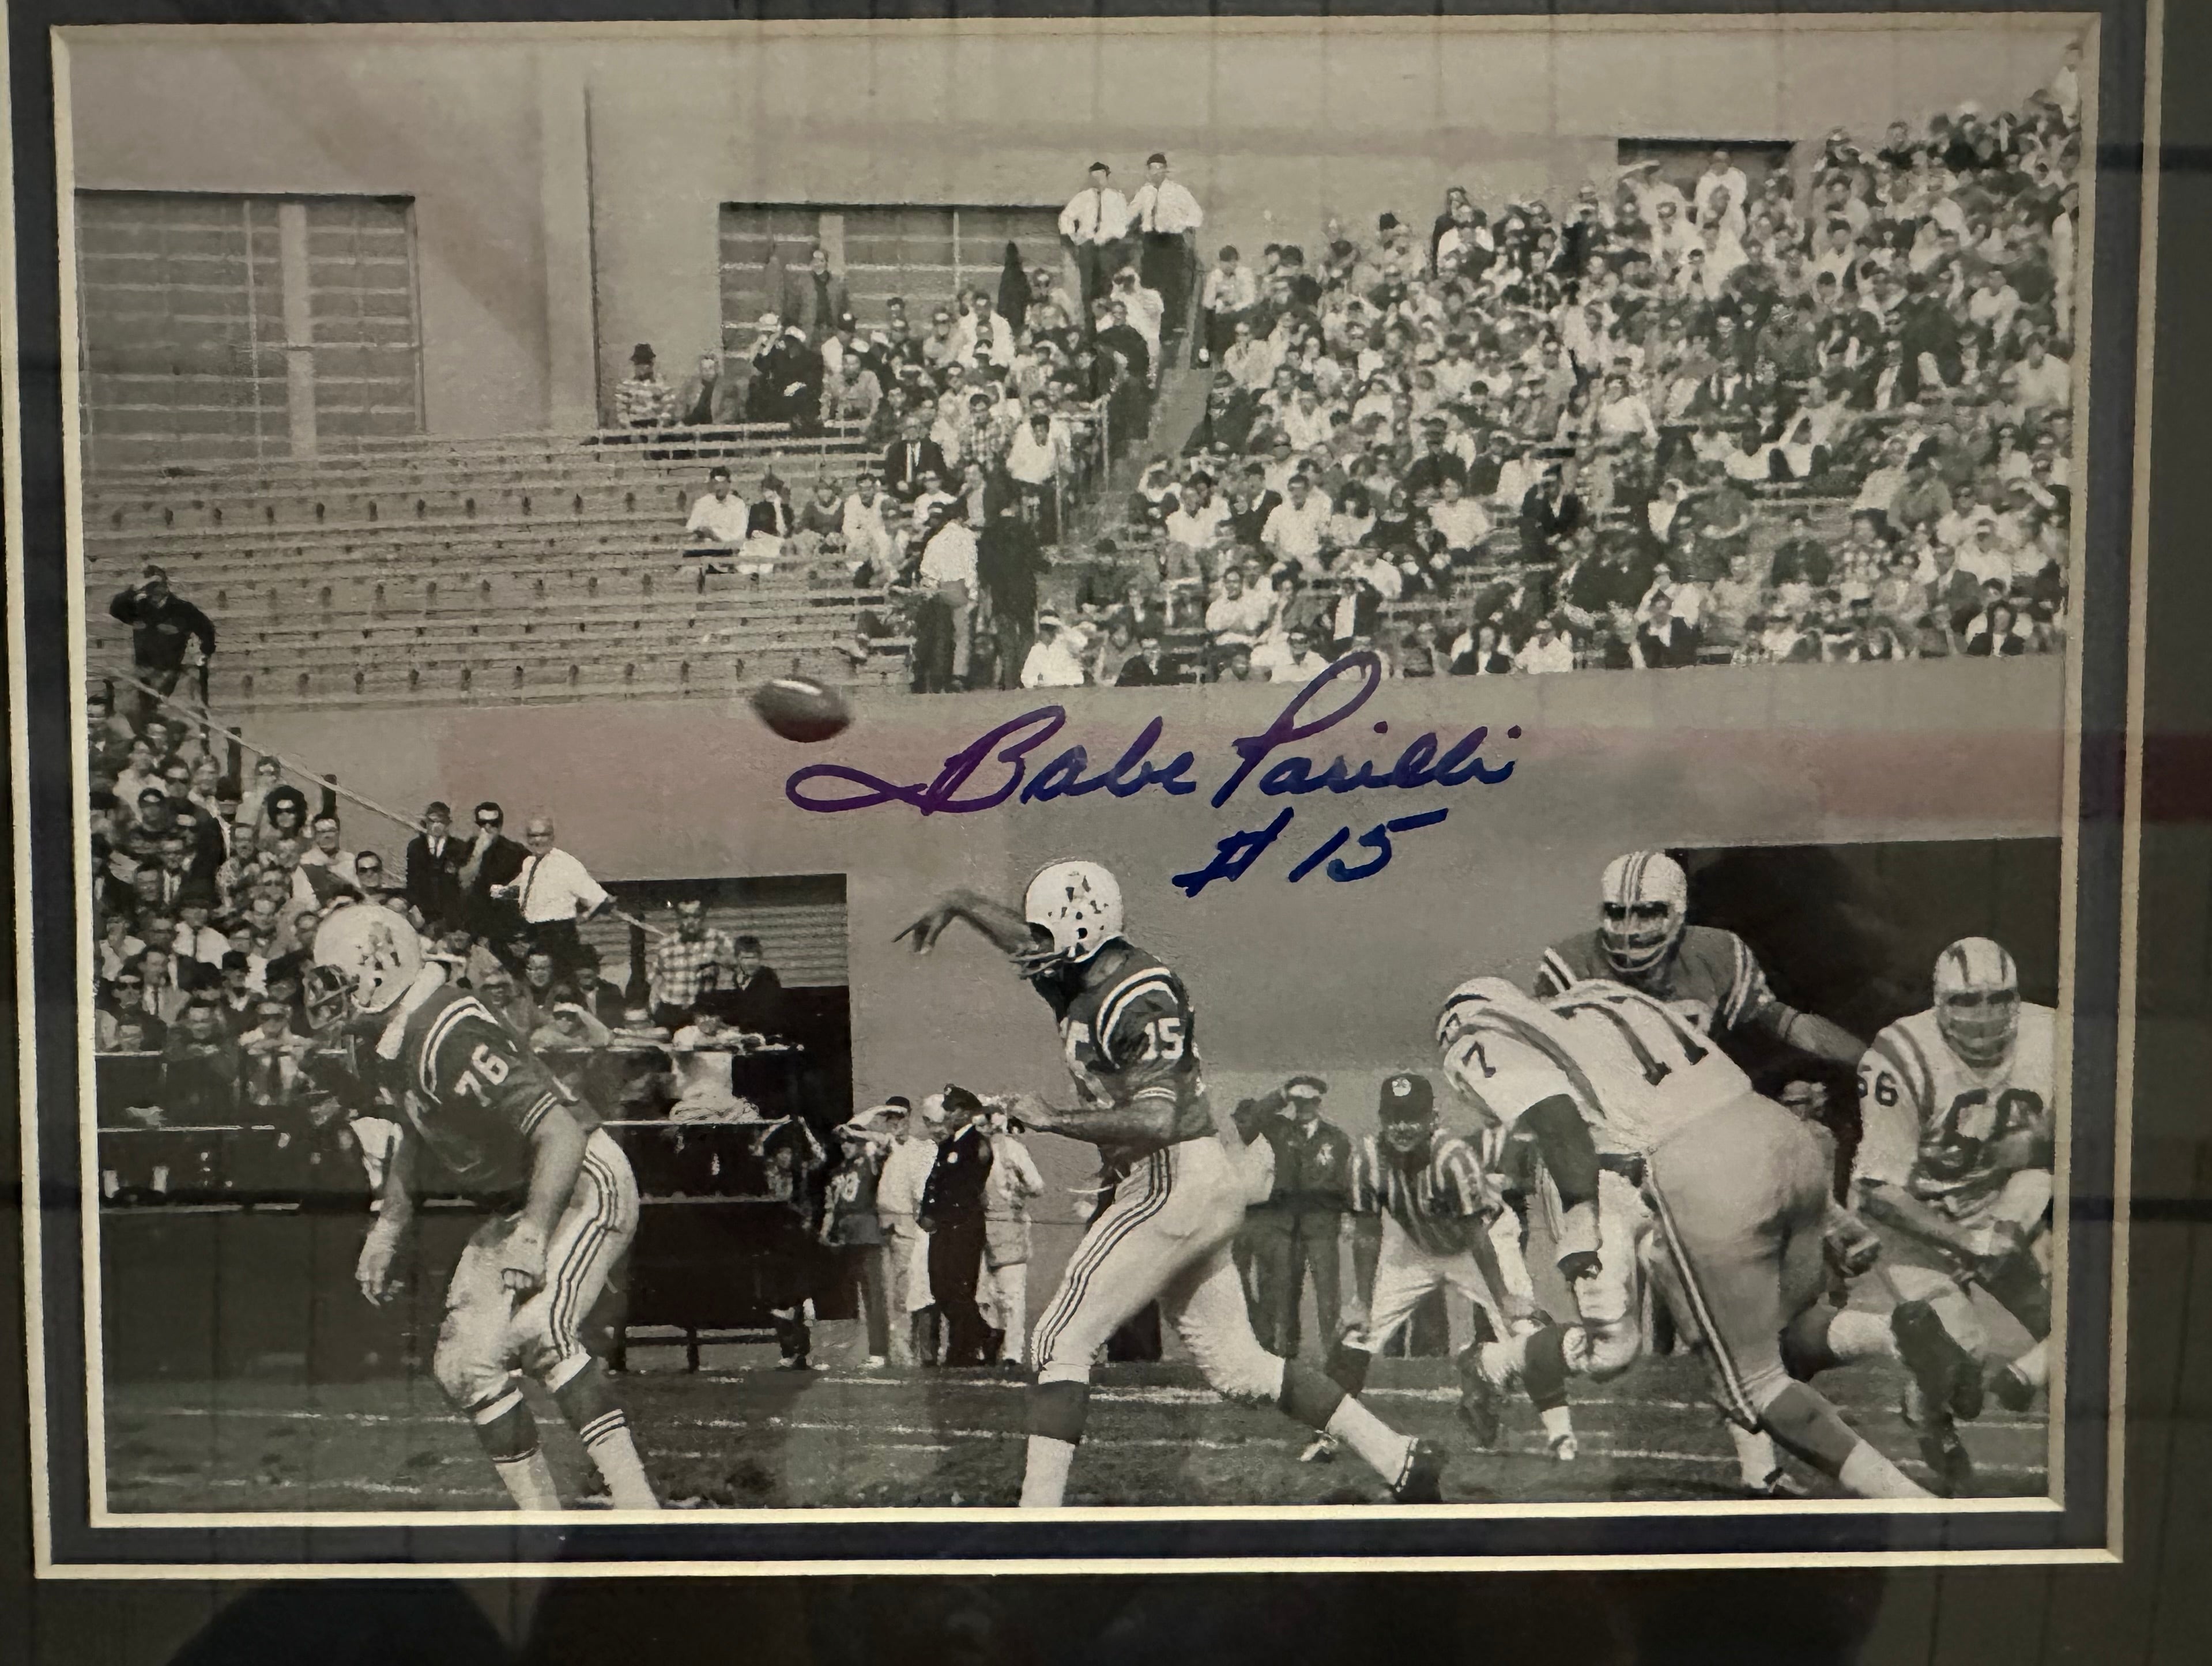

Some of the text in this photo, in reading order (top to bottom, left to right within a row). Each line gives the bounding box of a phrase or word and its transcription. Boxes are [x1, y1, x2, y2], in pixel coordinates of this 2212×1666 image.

[786, 704, 1196, 815] Babe
[1141, 1017, 1185, 1060] 15
[454, 1042, 509, 1107] 76
